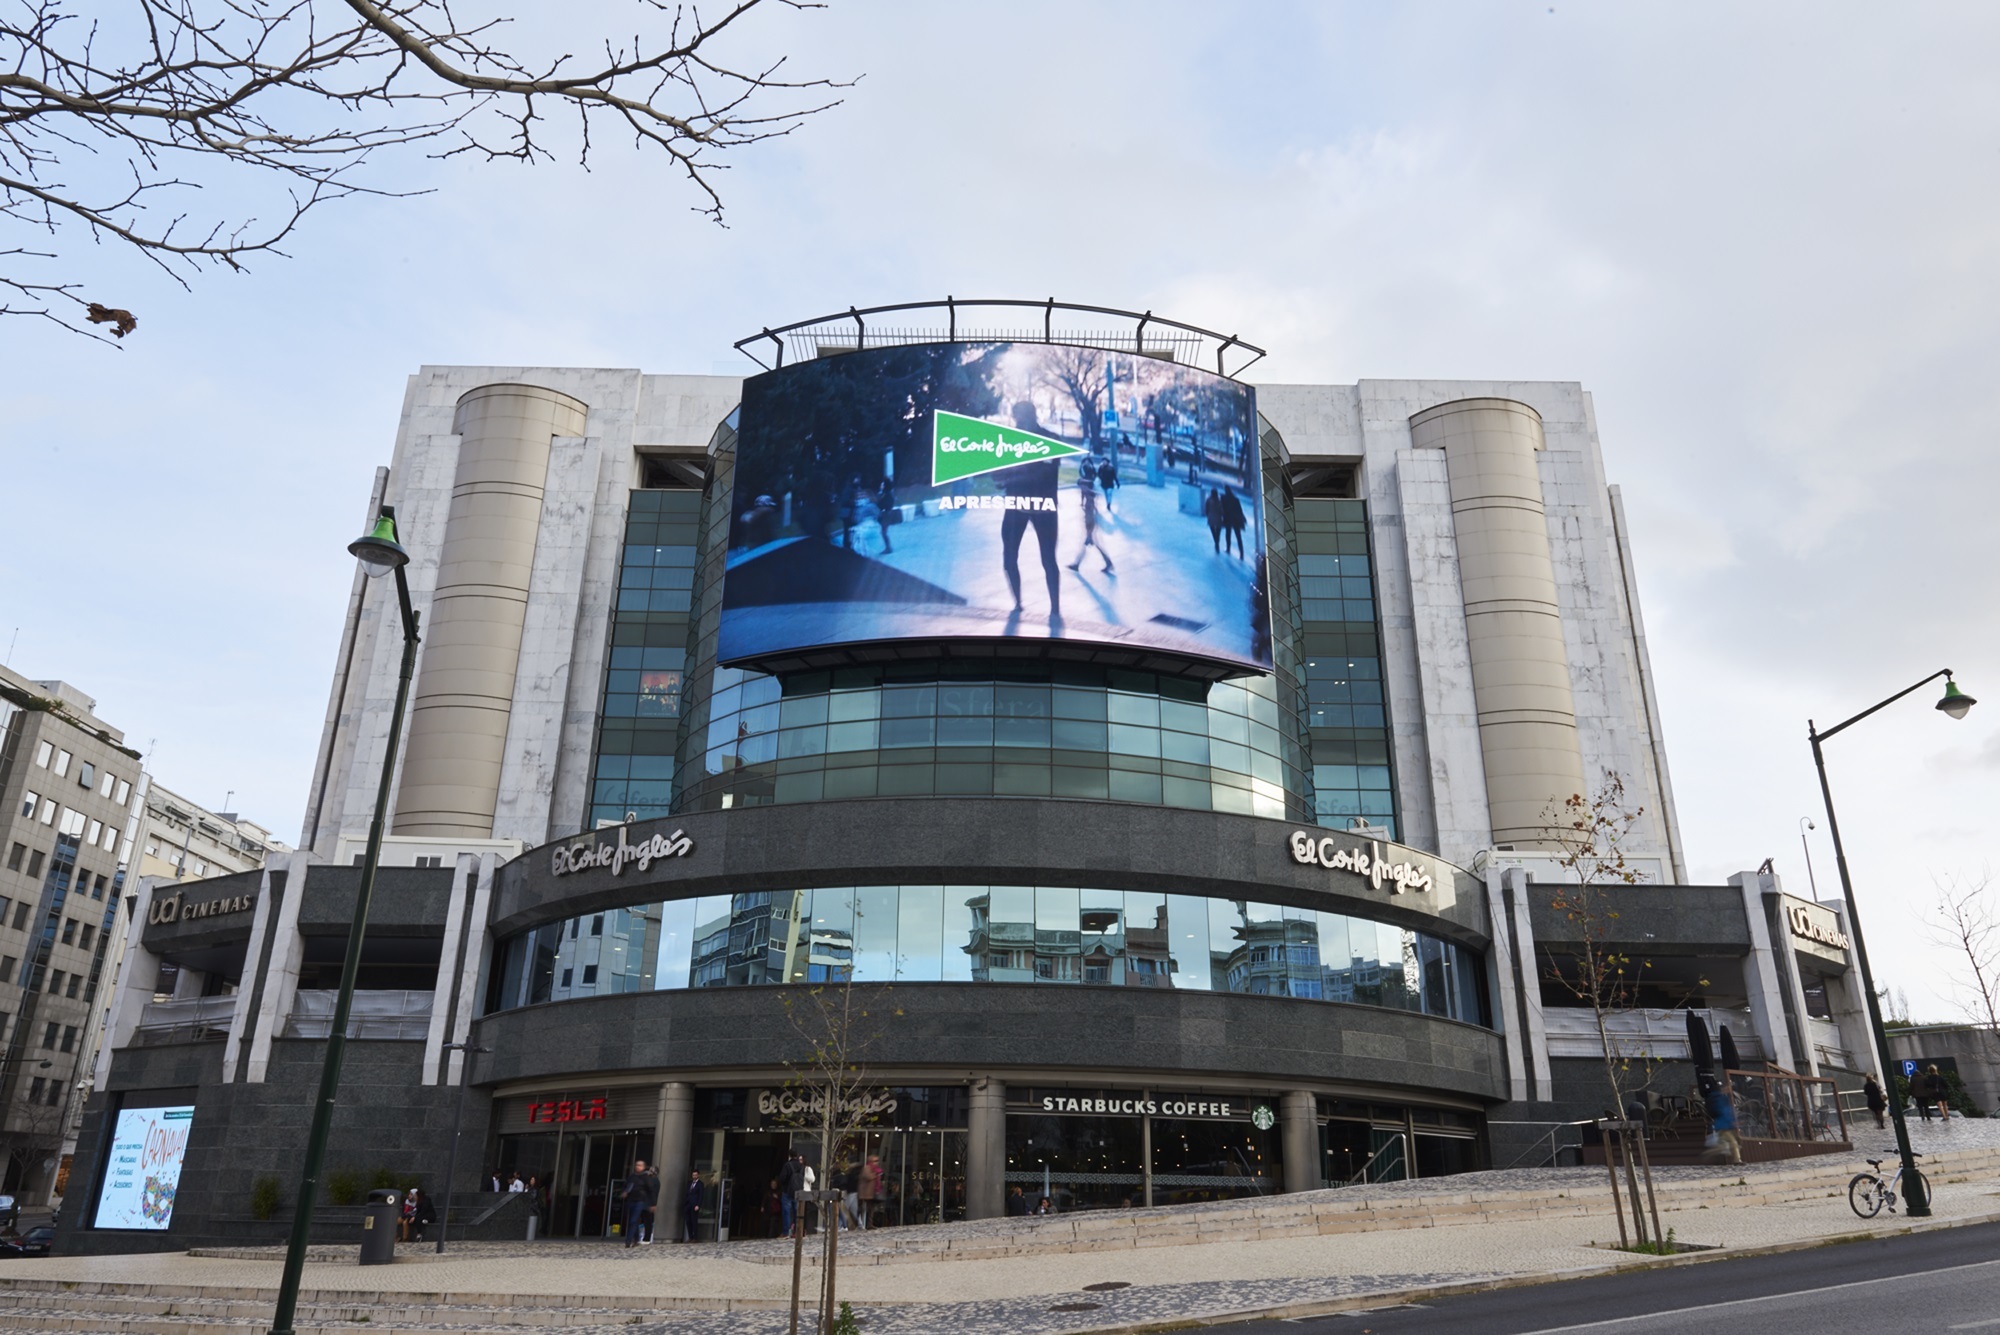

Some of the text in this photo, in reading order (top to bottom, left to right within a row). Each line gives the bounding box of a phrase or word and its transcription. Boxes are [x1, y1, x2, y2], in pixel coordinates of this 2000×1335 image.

[940, 434, 1051, 459] El Corte Inglés
[938, 495, 1057, 512] APRESENTA
[552, 826, 693, 877] El Corte Inglés
[1290, 830, 1433, 895] El Corte Inglés
[181, 894, 252, 920] CINEMAS
[1814, 925, 1850, 950] CINEMAS
[1905, 1061, 1915, 1075] P
[527, 1098, 607, 1124] TESLA
[758, 1090, 778, 1115] El
[778, 1091, 825, 1115] Corte
[1042, 1096, 1232, 1117] STARBUCKS COFFEE
